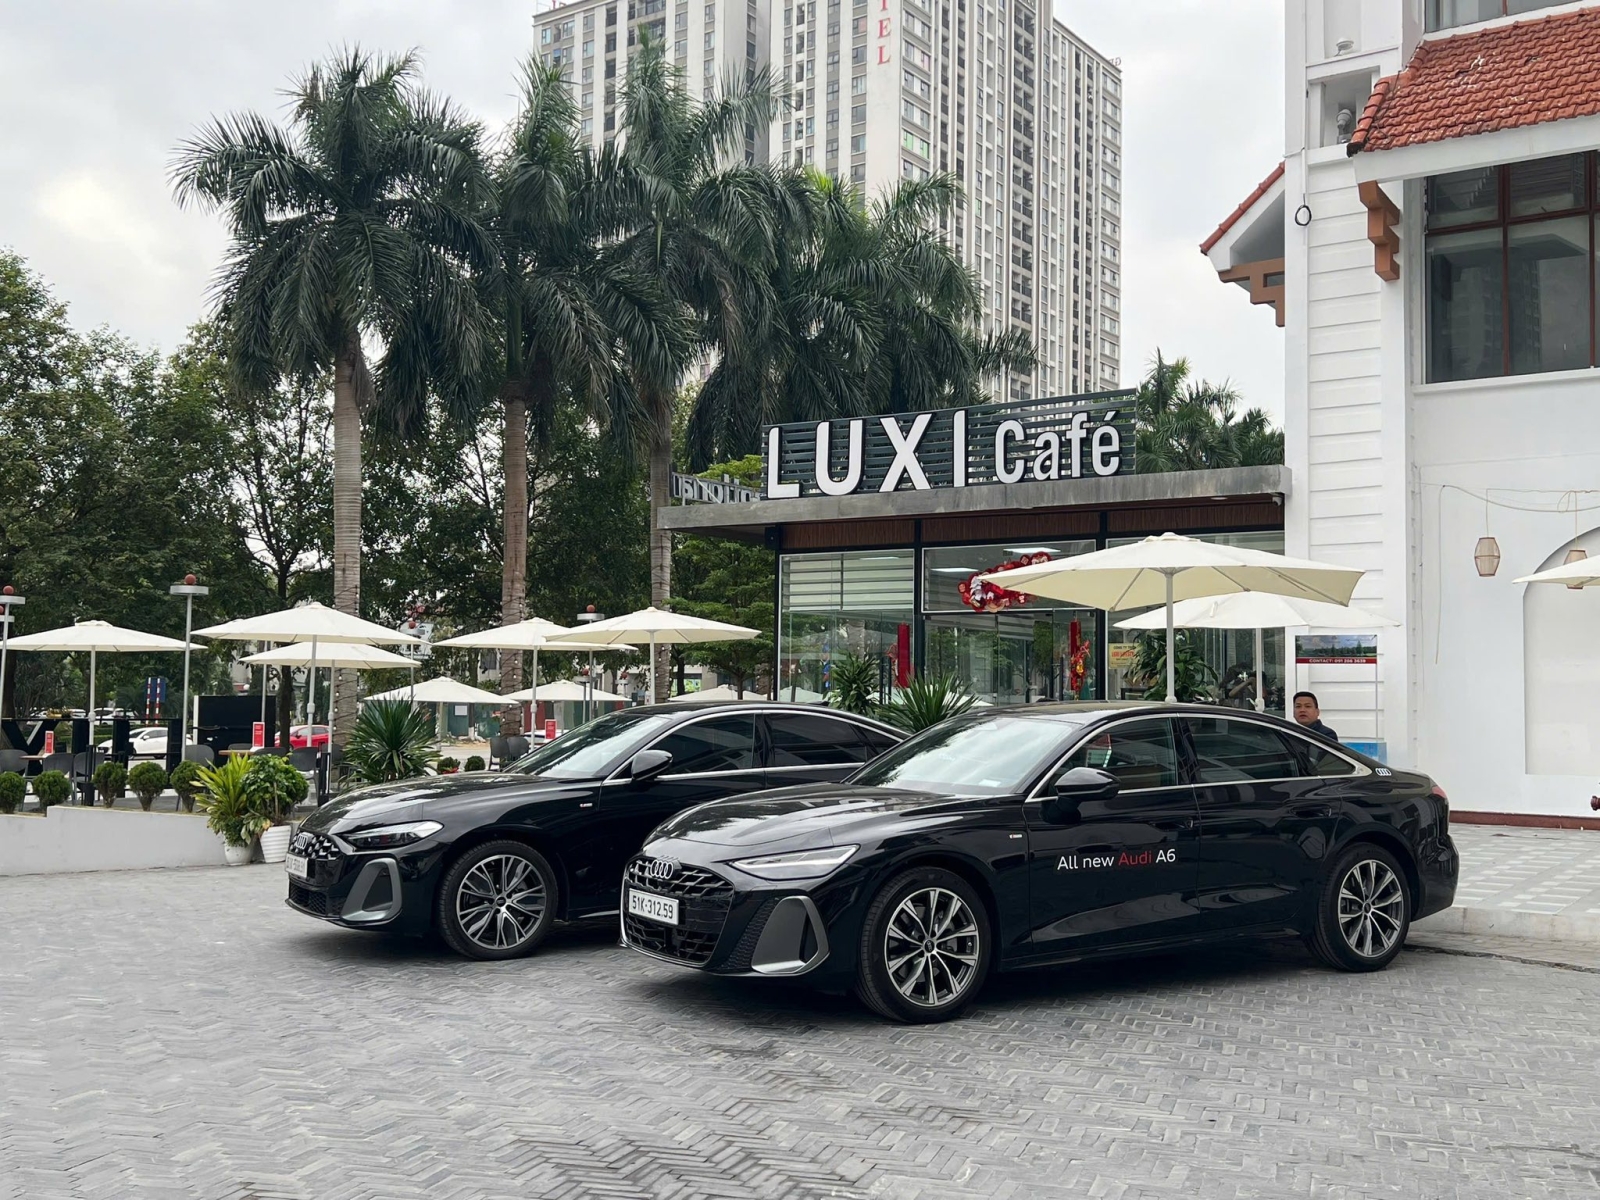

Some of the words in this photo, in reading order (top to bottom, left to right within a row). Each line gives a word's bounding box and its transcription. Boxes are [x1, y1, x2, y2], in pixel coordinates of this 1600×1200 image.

[995, 410, 1121, 485] Café
[1057, 855, 1079, 870] All
[1082, 856, 1115, 869] new
[1118, 850, 1152, 867] Audi
[1155, 848, 1176, 864] A6
